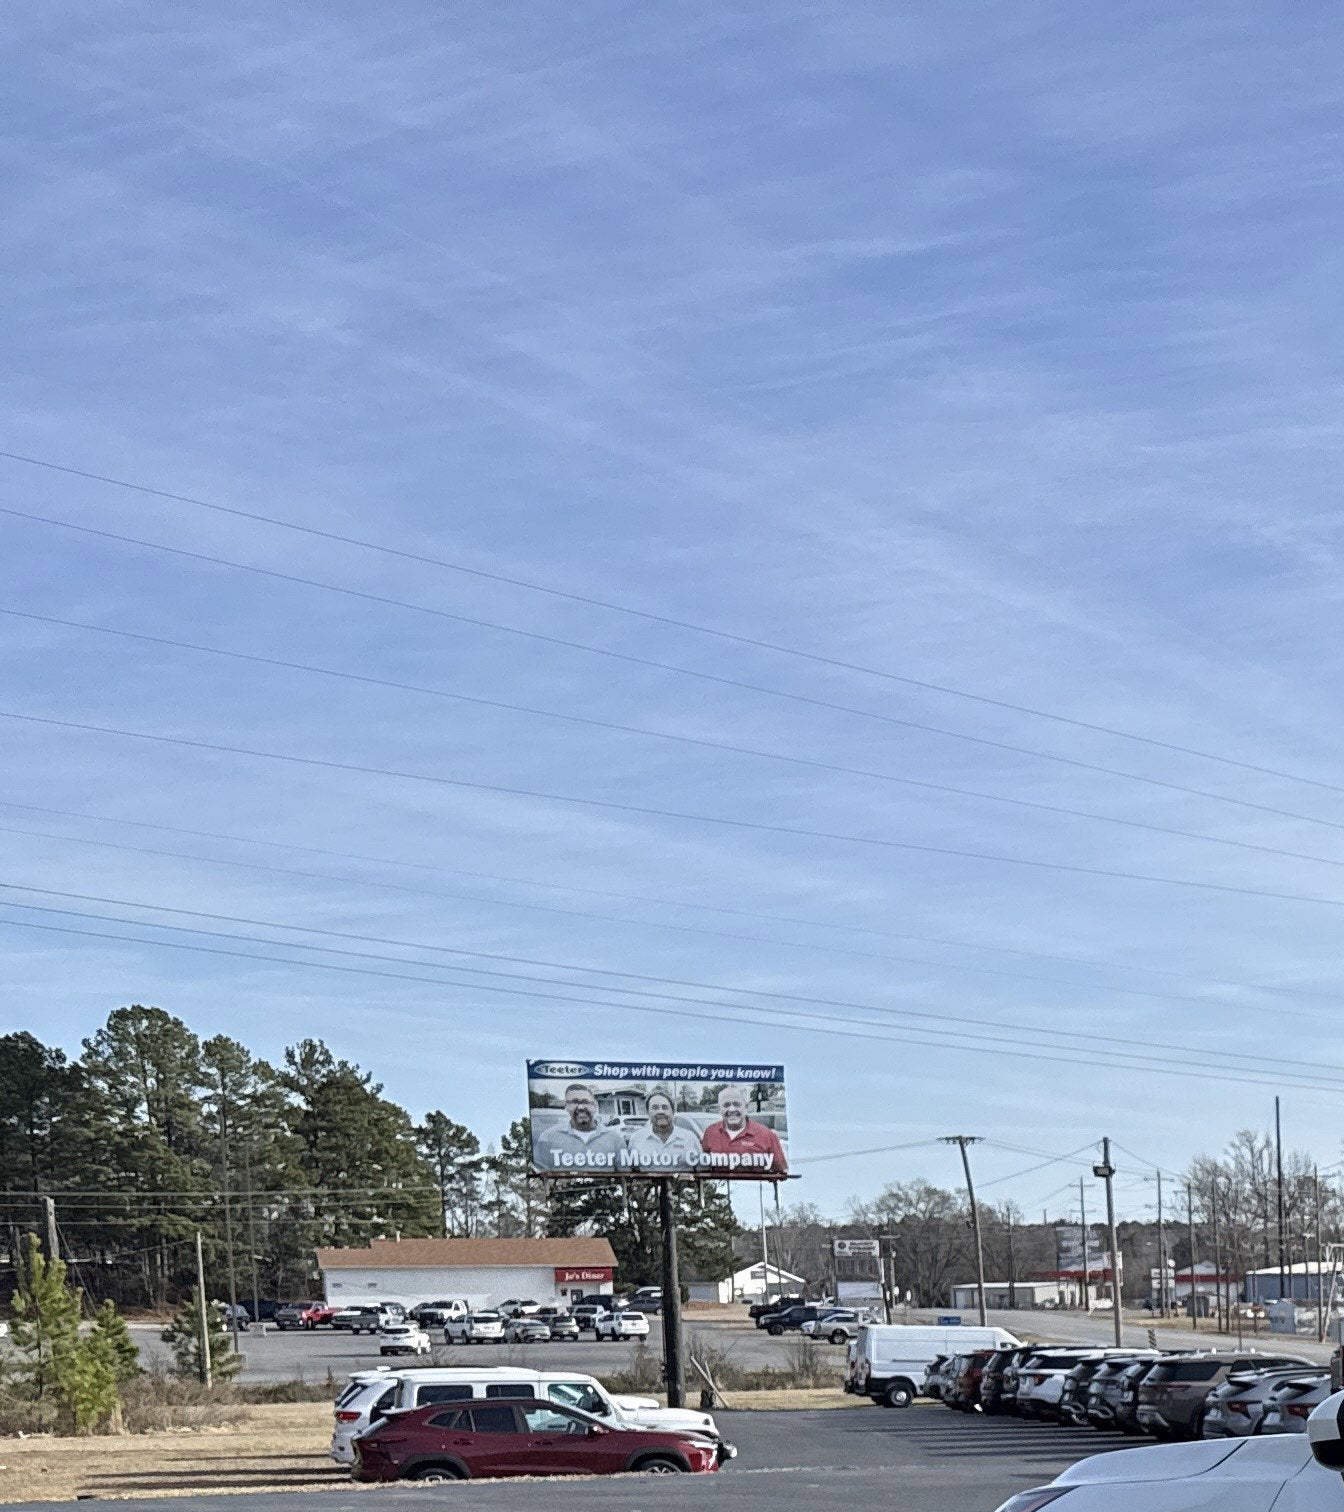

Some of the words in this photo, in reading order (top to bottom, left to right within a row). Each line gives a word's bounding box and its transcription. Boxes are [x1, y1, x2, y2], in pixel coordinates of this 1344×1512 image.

[543, 1065, 582, 1074] Teeter
[593, 1063, 629, 1079] Shop
[631, 1064, 660, 1077] with
[710, 1068, 734, 1080] you
[736, 1067, 776, 1079] know!
[550, 1149, 616, 1167] Teeter
[620, 1150, 683, 1167] Motor
[685, 1150, 774, 1170] Company
